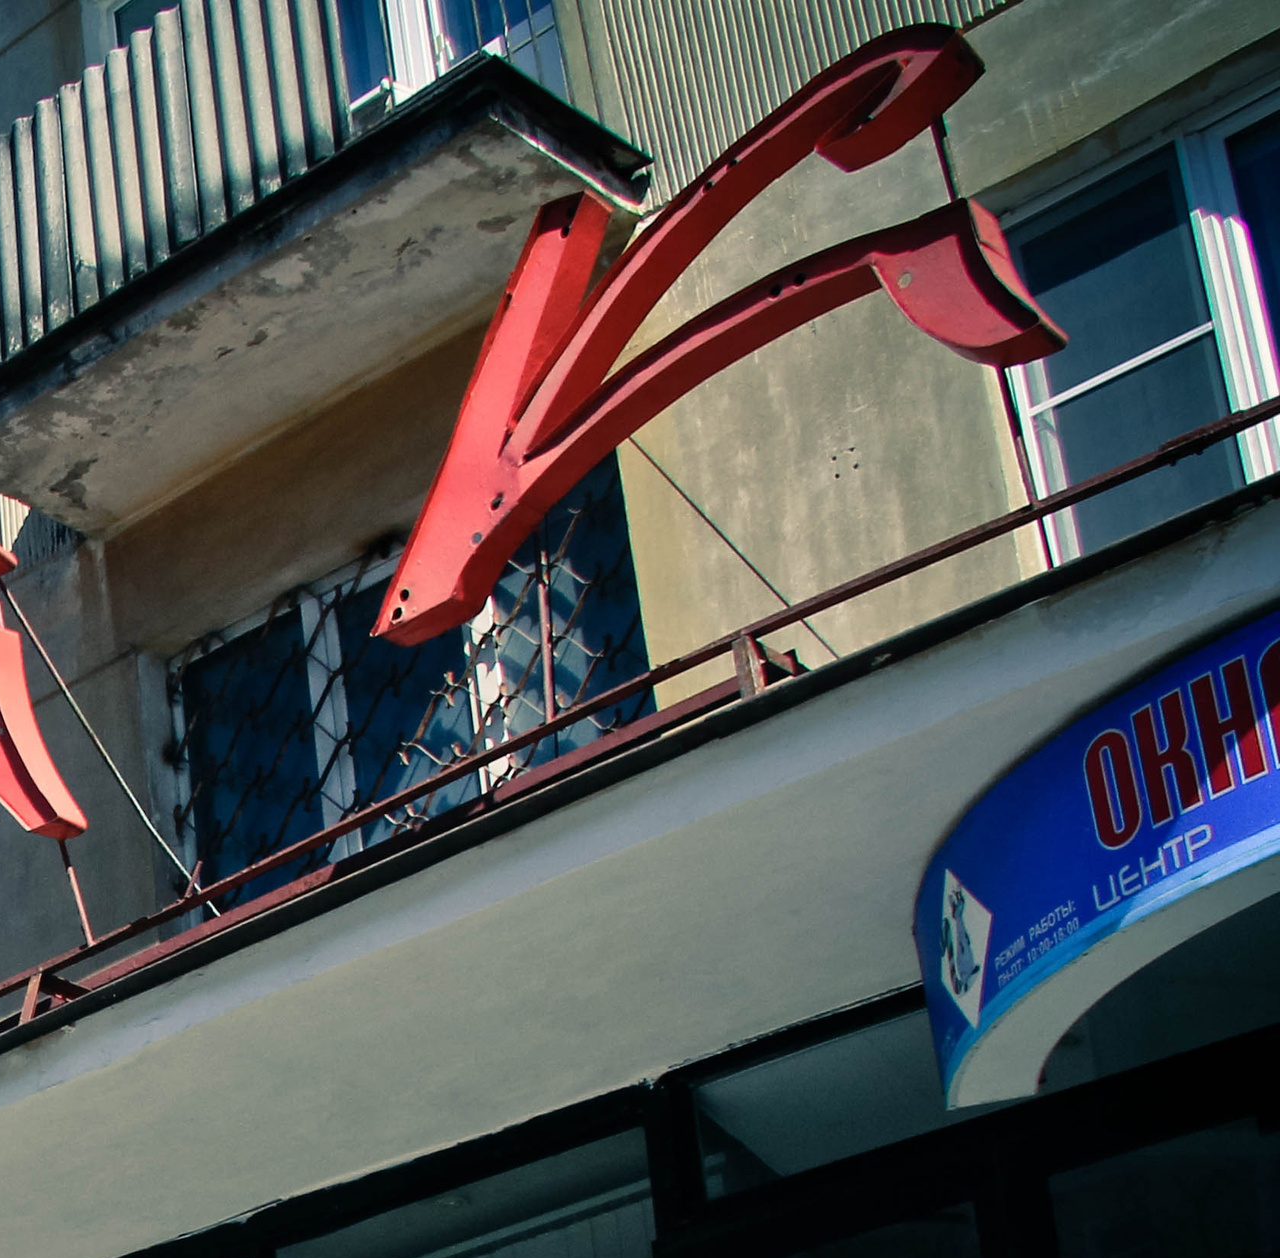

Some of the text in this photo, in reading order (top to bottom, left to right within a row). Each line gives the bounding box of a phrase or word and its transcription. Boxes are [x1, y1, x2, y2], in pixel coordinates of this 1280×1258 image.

[1091, 822, 1214, 912] ЦЕНТР
[994, 899, 1076, 971] РЕЖИМ РАБОТЫ:
